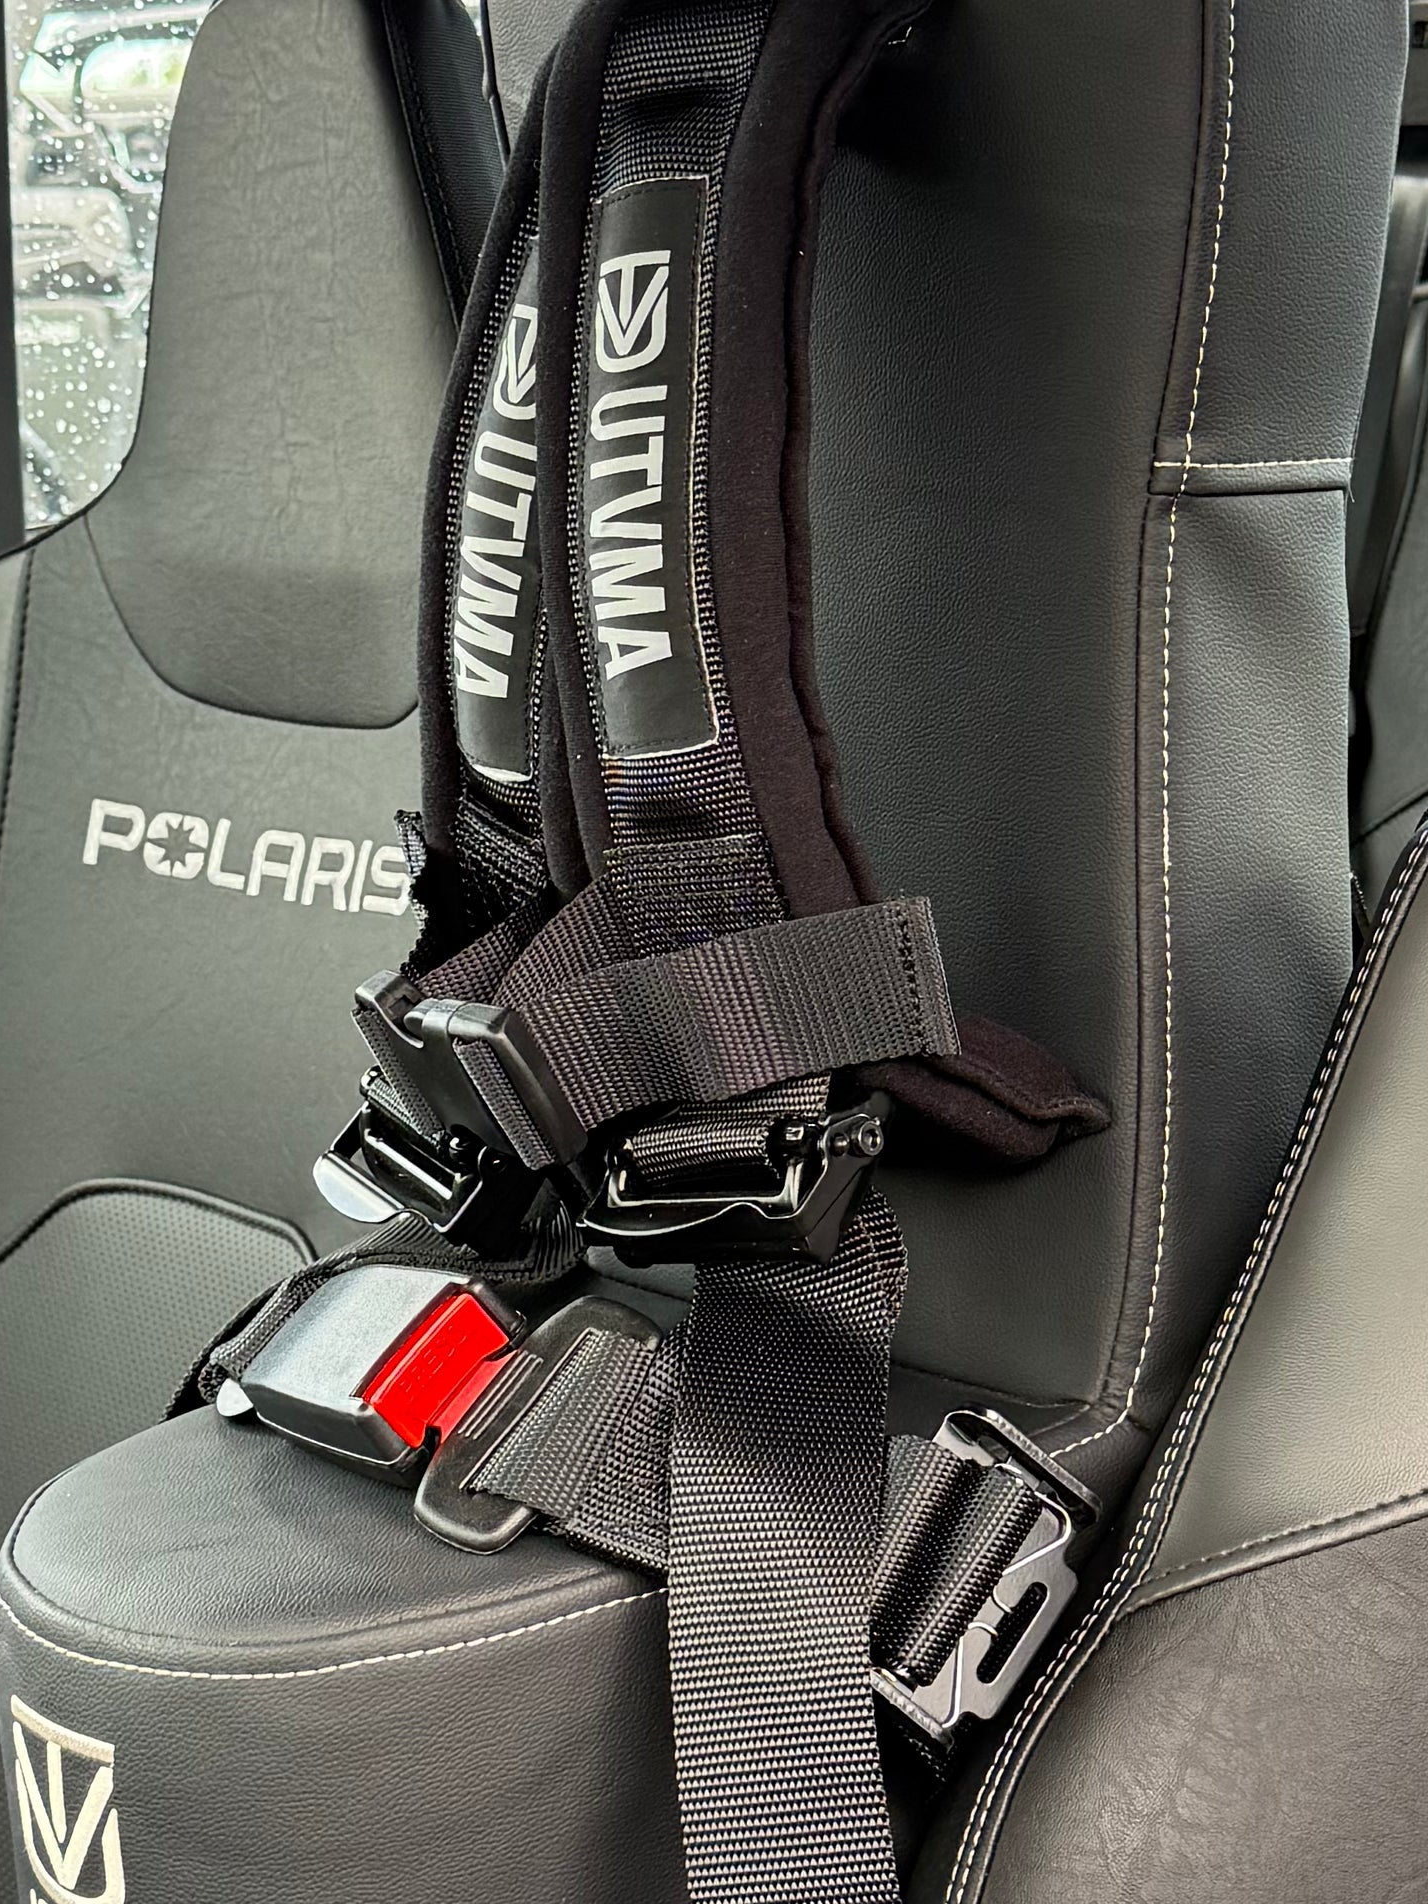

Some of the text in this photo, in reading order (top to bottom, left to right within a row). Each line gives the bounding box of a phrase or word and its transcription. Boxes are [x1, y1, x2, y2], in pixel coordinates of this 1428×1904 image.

[454, 430, 537, 699] UTVMA
[589, 384, 673, 679] UTVMA
[81, 797, 413, 916] POLARIS
